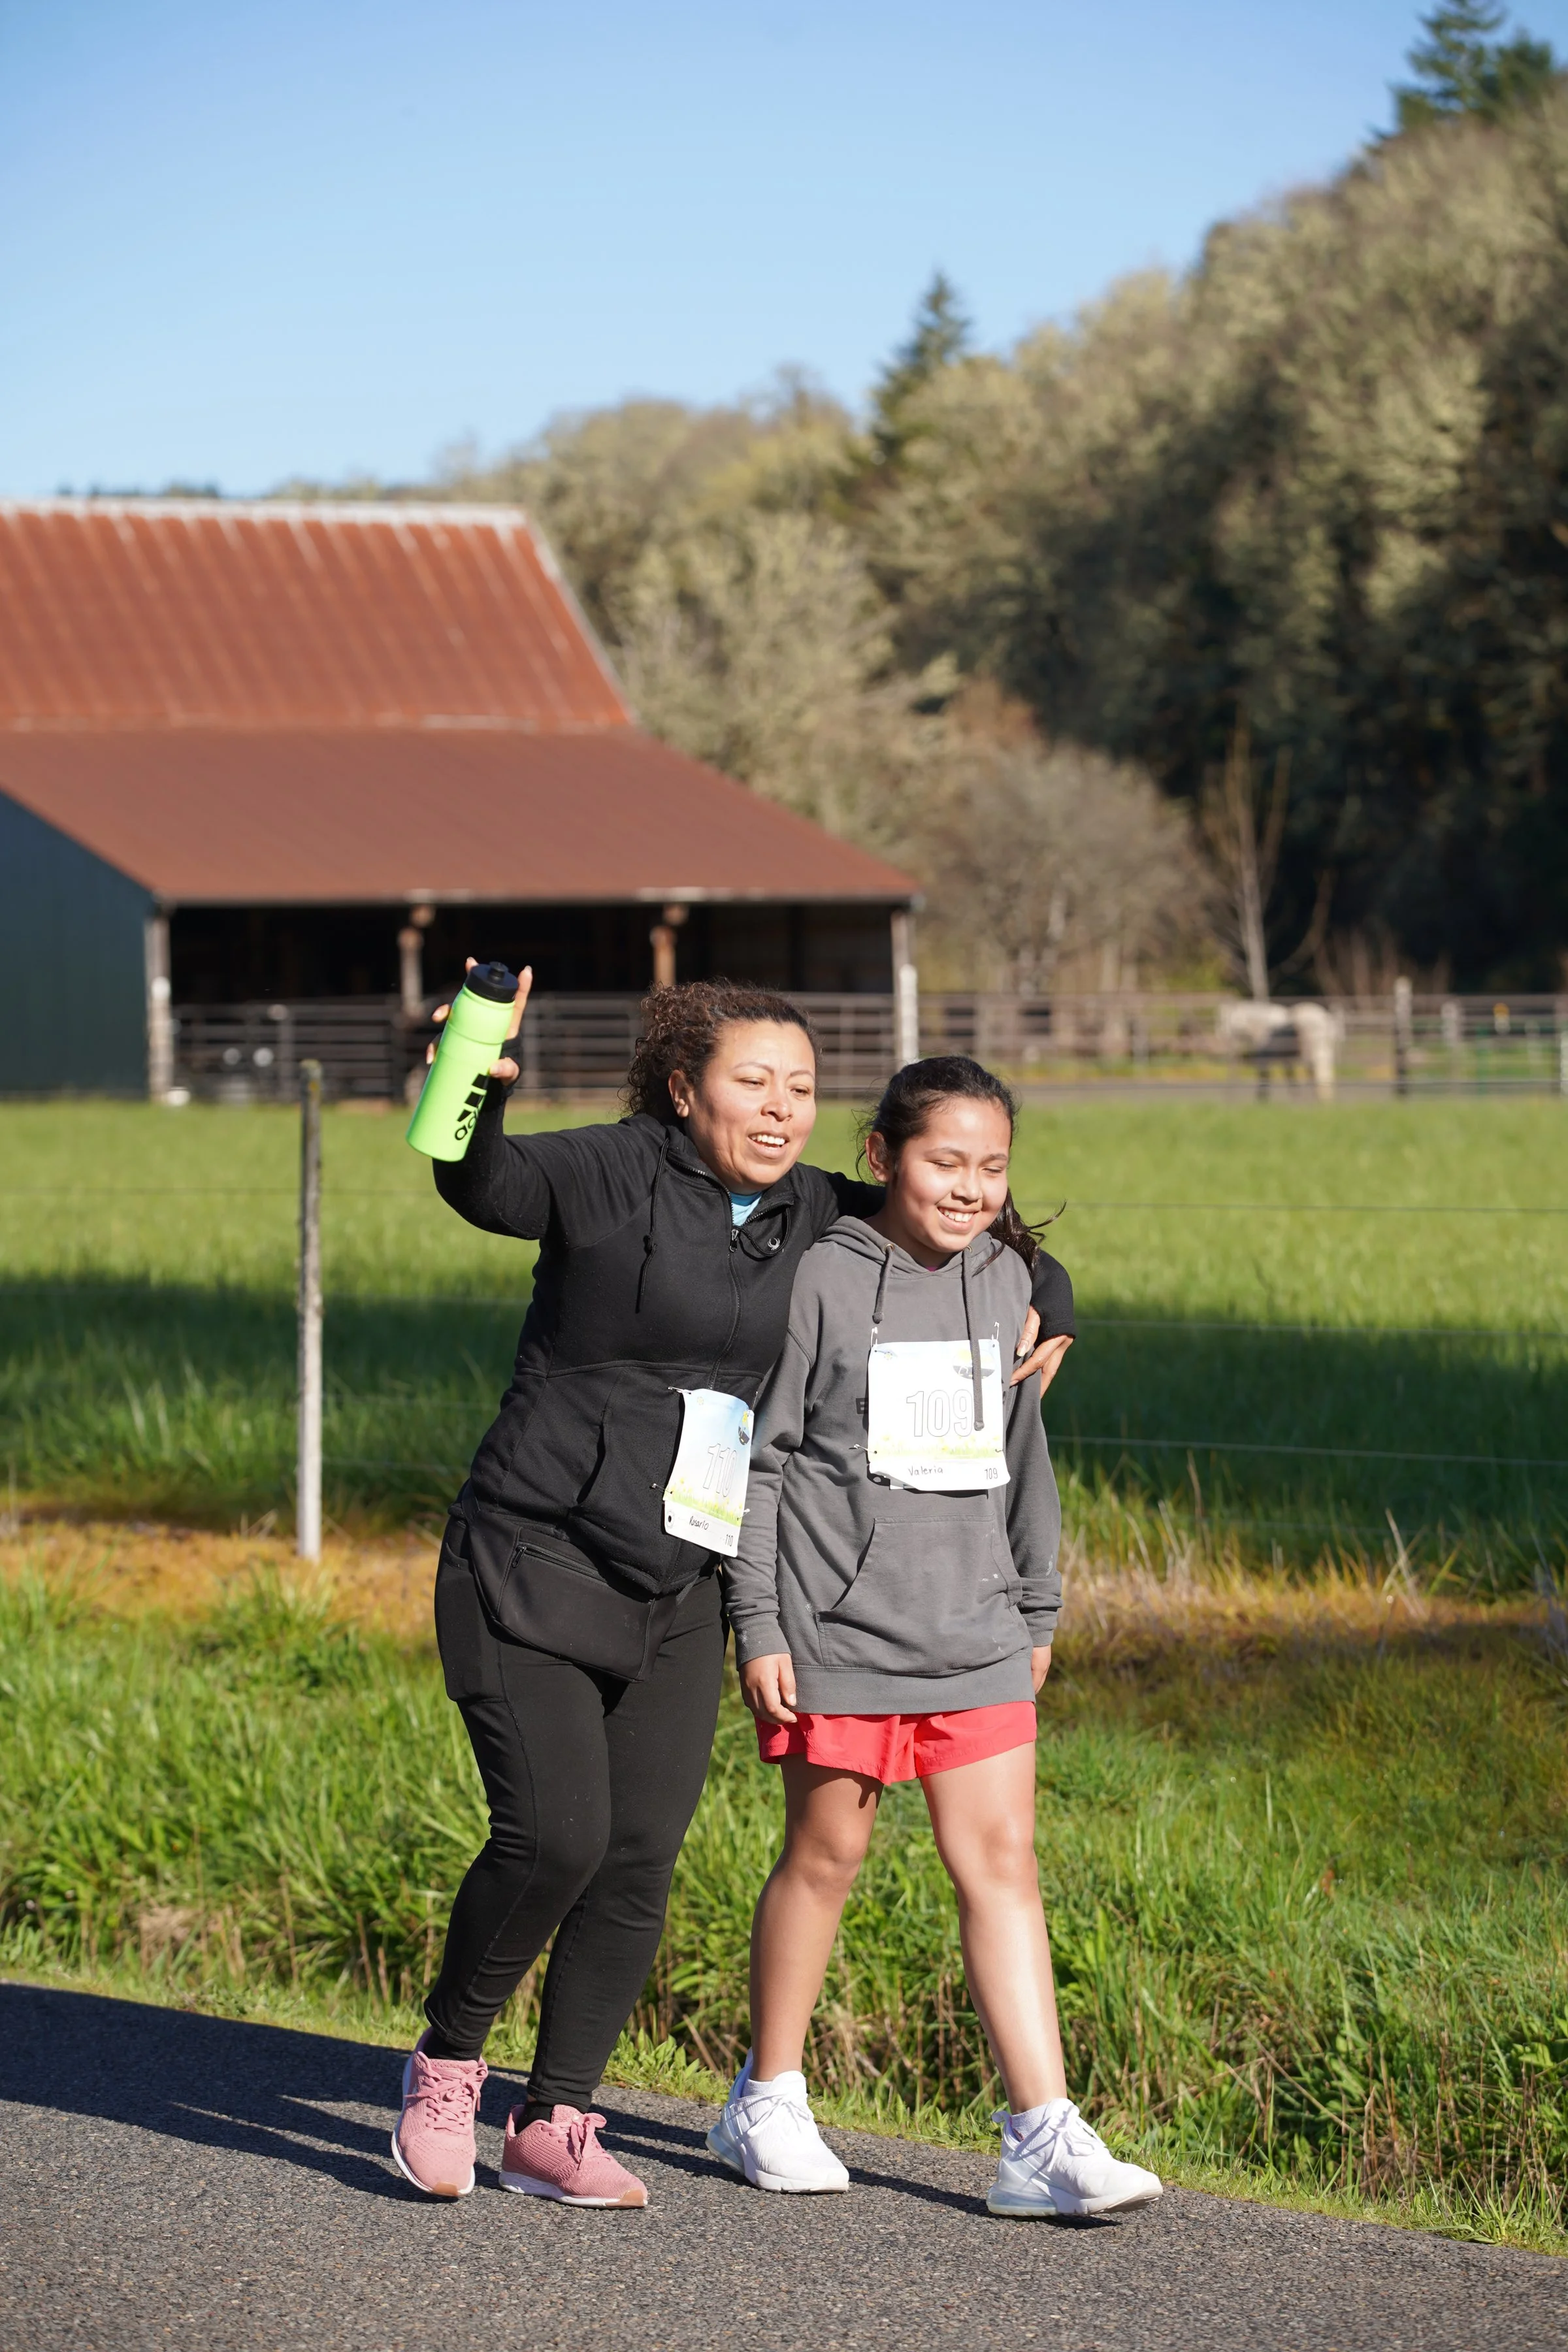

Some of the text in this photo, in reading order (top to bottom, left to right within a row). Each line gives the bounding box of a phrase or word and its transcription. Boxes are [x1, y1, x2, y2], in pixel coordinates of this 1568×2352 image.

[906, 1389, 973, 1437] 109
[703, 1443, 738, 1497] 110
[908, 1465, 943, 1477] Valeria
[984, 1467, 998, 1480] 109
[689, 1516, 710, 1530] Rosario
[725, 1534, 734, 1547] 110
